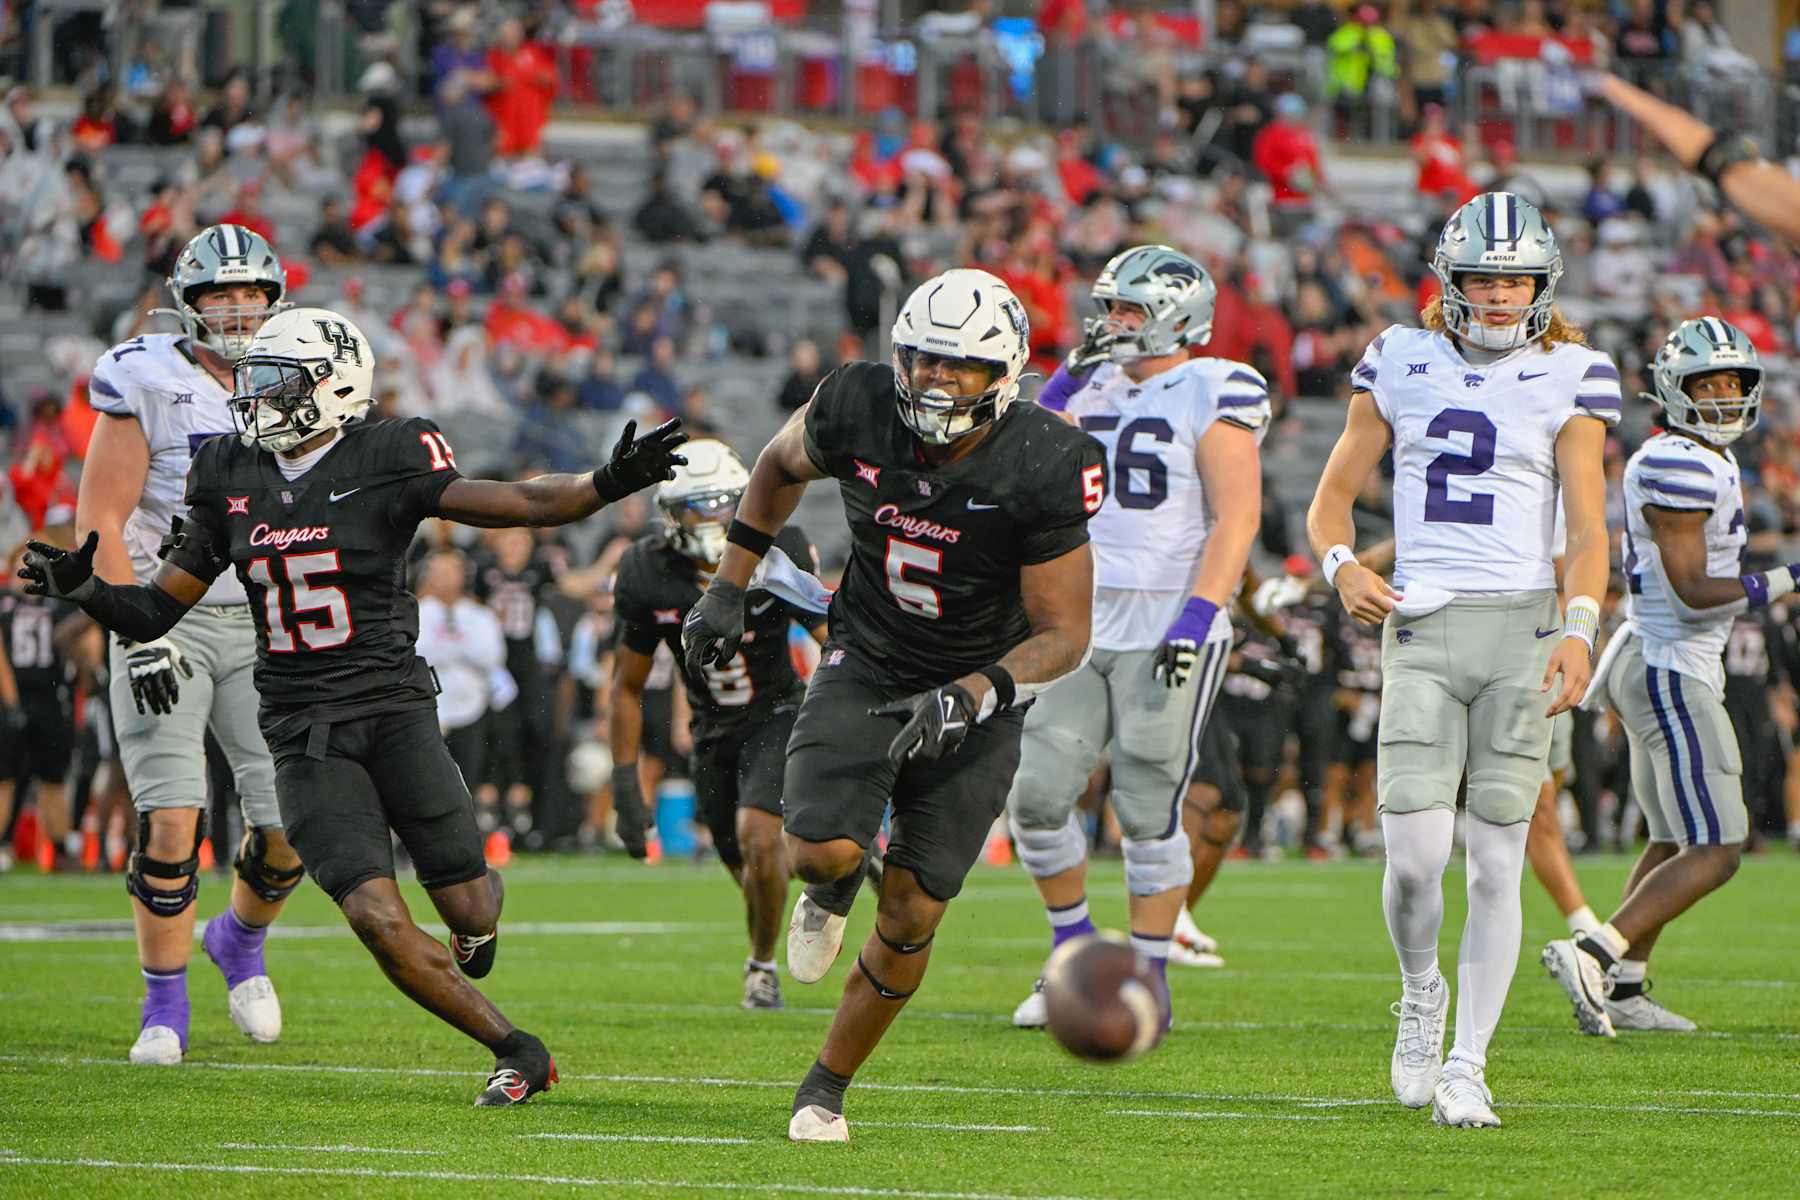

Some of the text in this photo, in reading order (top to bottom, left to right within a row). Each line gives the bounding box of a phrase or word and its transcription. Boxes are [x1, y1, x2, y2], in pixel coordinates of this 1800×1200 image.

[1407, 362, 1431, 377] XII
[1081, 463, 1105, 513] 5
[1424, 408, 1497, 526] 2
[250, 523, 330, 550] Cougars
[874, 503, 961, 544] Cougars
[248, 550, 354, 653] 15
[885, 535, 943, 620] 5
